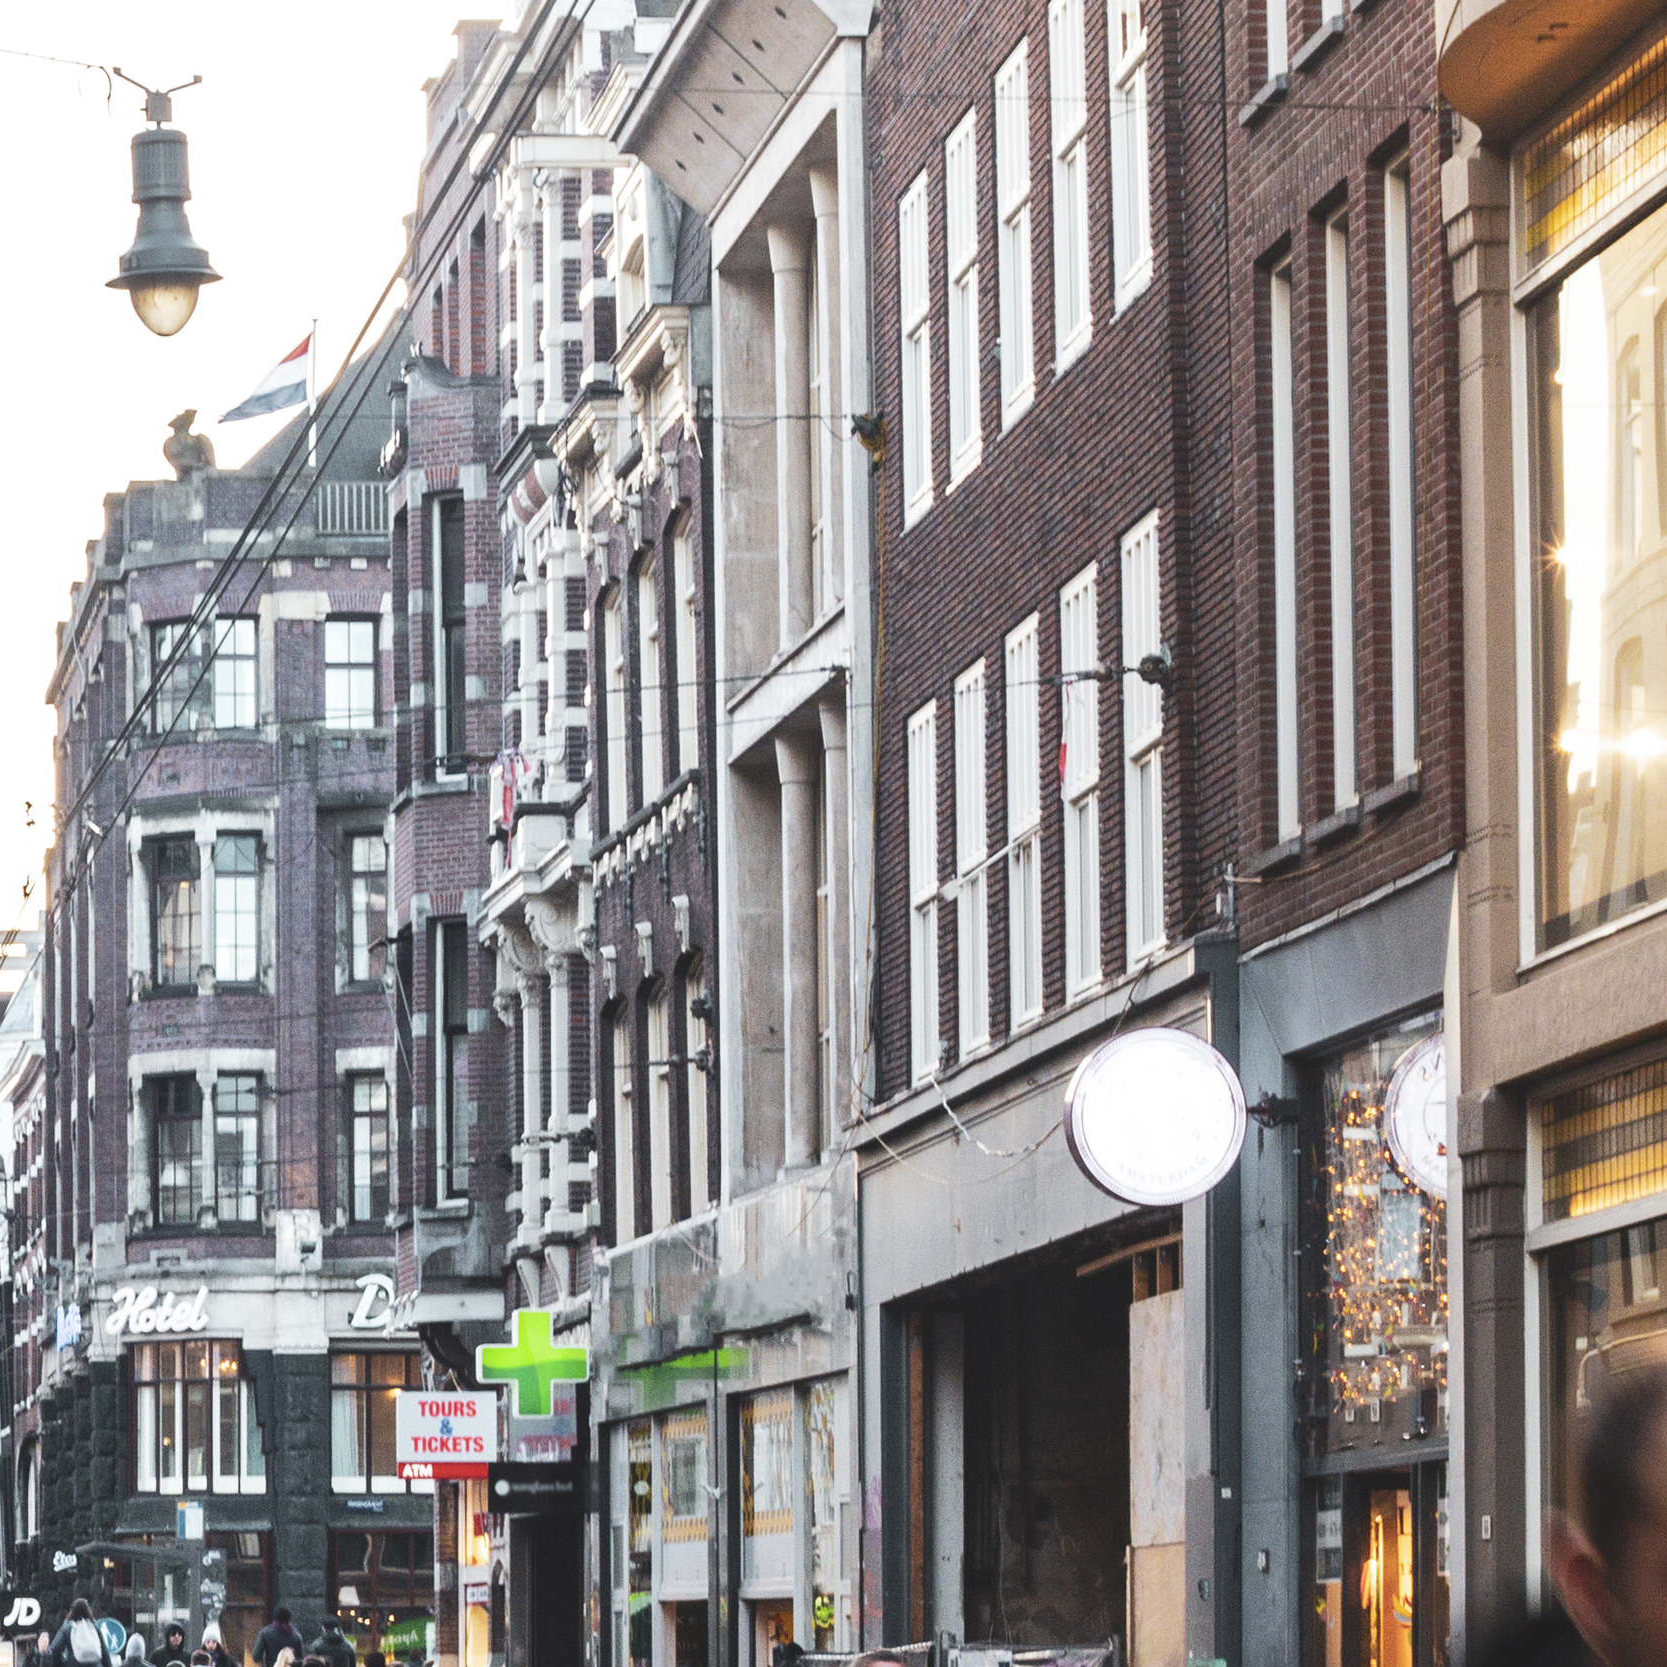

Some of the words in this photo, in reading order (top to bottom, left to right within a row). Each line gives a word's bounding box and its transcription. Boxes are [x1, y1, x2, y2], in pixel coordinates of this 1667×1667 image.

[105, 1285, 210, 1335] Hotel
[418, 1400, 477, 1417] TOURS
[439, 1416, 453, 1437] &
[411, 1436, 485, 1453] TICKETS
[402, 1463, 434, 1478] ATM
[3, 1597, 42, 1627] JD
